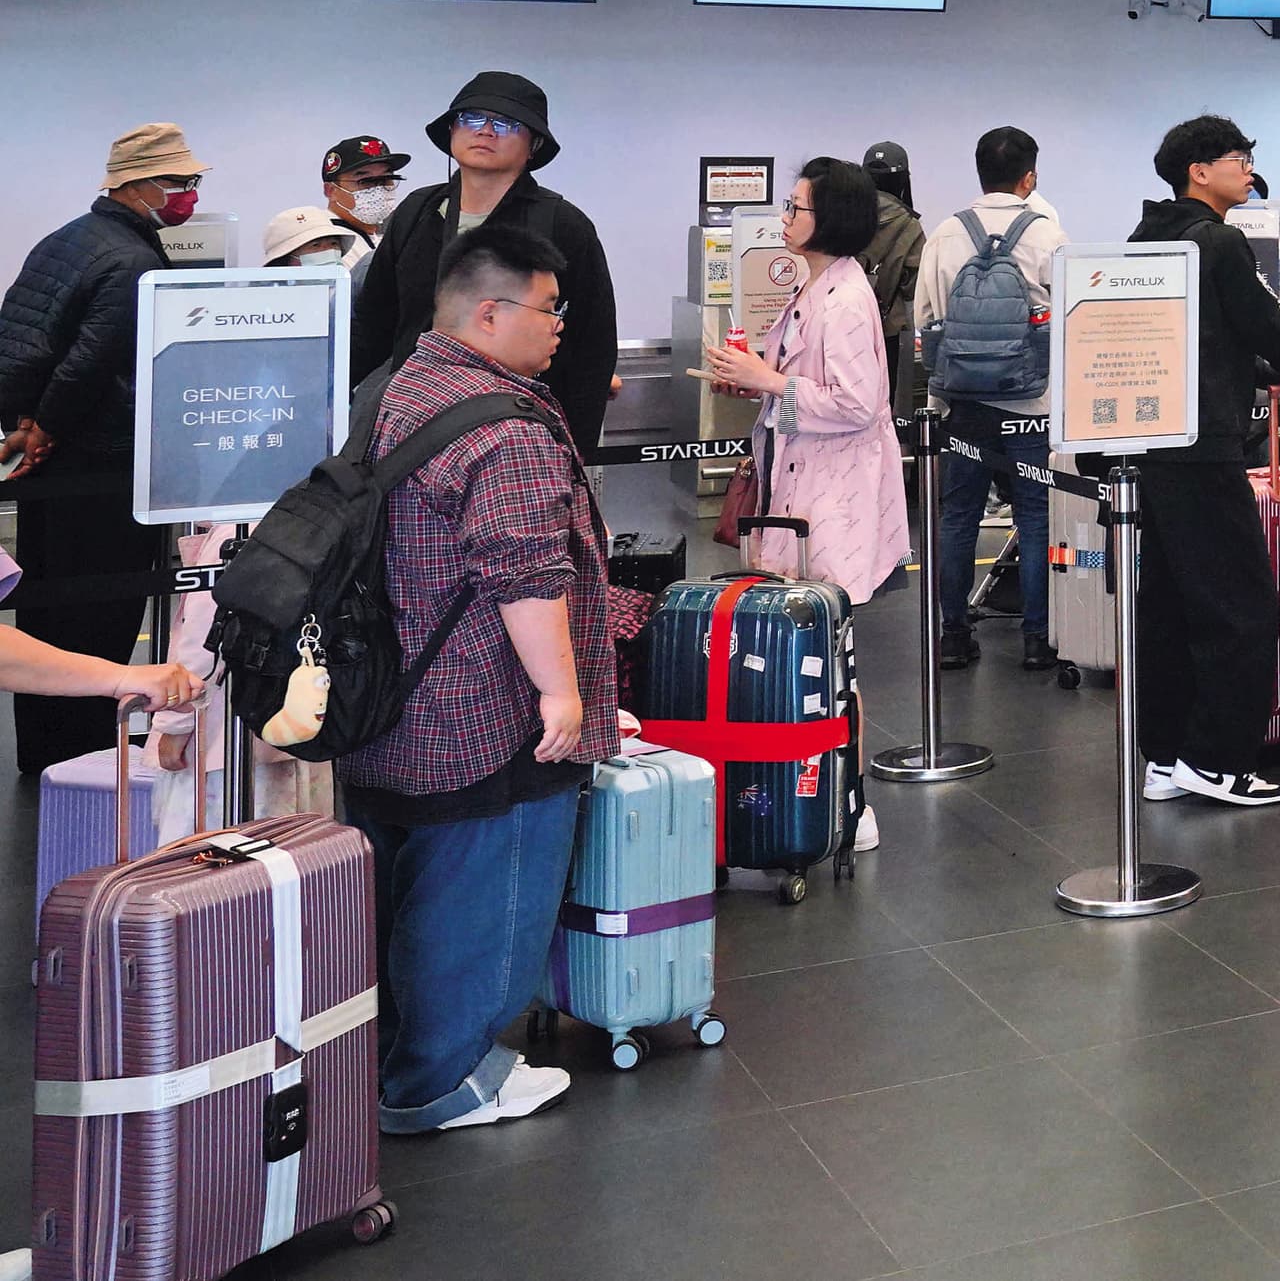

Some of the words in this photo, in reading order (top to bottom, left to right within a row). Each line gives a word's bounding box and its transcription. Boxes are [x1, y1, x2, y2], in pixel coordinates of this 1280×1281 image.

[1110, 277, 1165, 288] STARLUX
[215, 312, 295, 326] STARLUX
[183, 385, 296, 403] GENERAL
[183, 406, 294, 426] CHECK-IN
[192, 433, 283, 452] 一般報到
[640, 439, 745, 462] STARLUX
[948, 436, 983, 463] STARLUX
[1016, 460, 1056, 488] STARLUX
